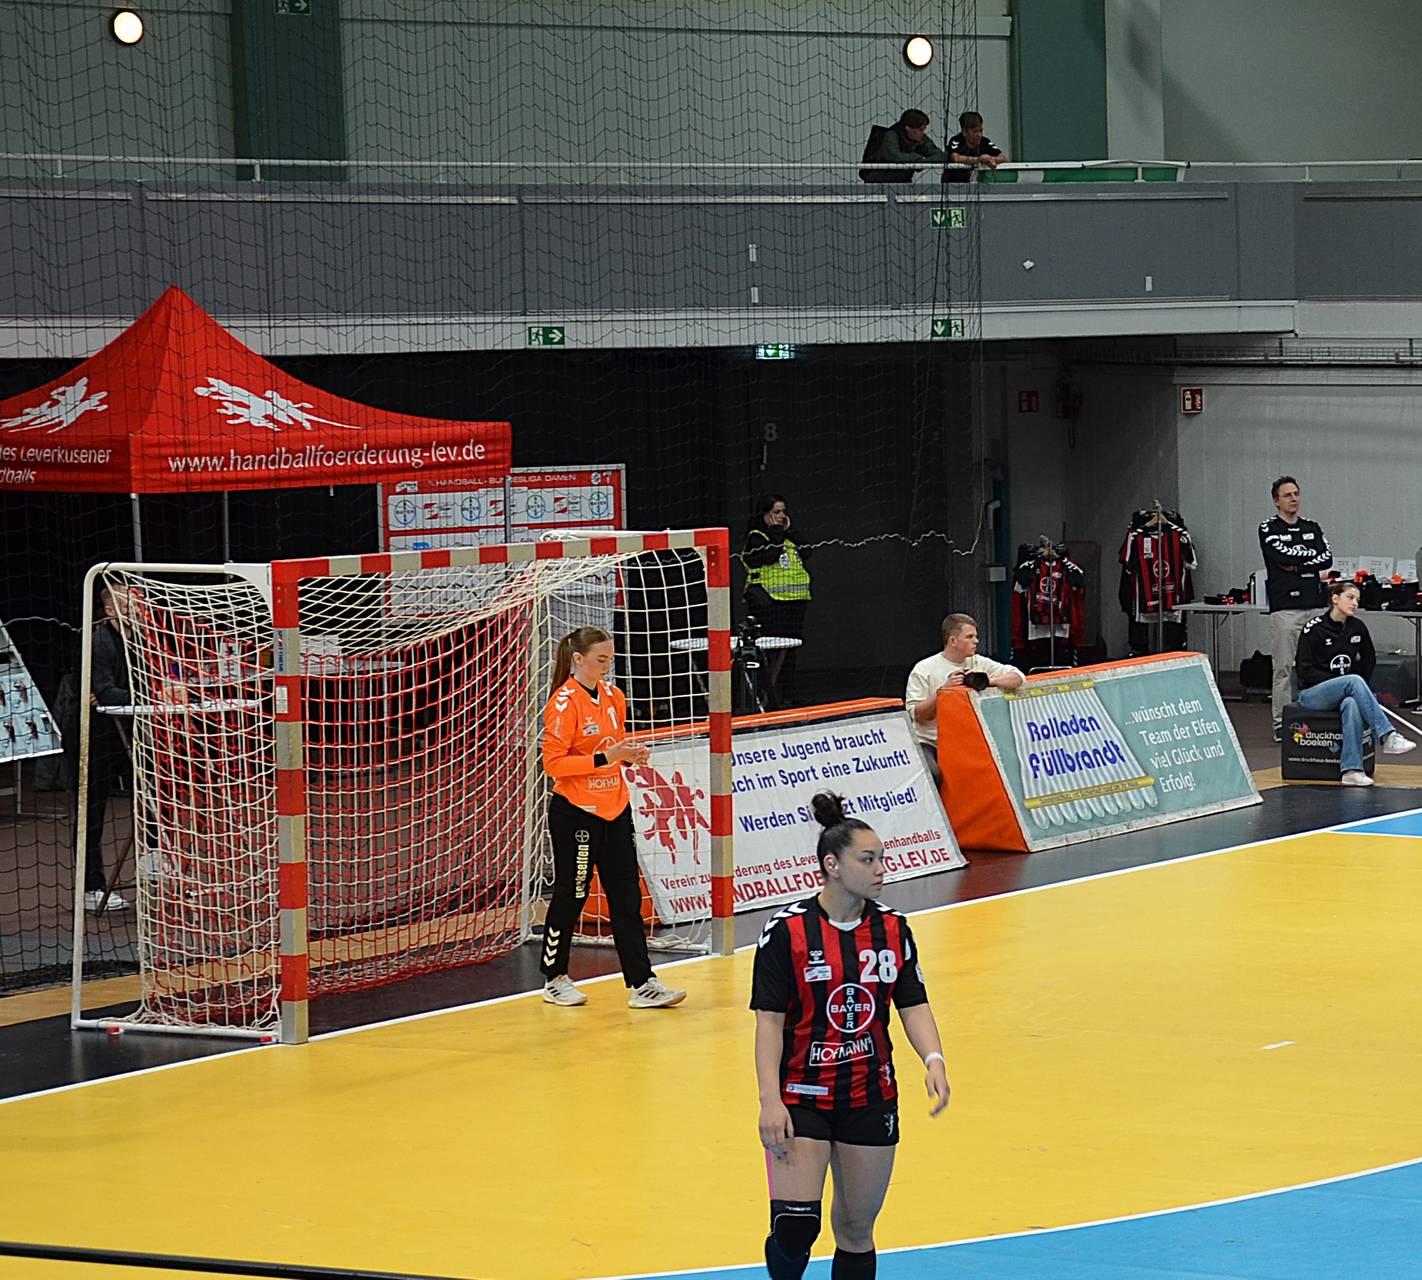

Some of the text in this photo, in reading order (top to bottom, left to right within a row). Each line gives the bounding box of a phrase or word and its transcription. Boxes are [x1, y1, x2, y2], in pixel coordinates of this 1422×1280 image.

[20, 445, 112, 464] Leverkusener
[168, 439, 485, 474] www.handballfoerderung-lev.de
[1179, 698, 1203, 715] dem
[1027, 714, 1101, 742] Rolladen
[1139, 718, 1220, 746] Team der Elfen
[781, 740, 830, 763] Jugend
[833, 729, 887, 751] braucht
[1150, 740, 1225, 769] viel Glück und
[1300, 739, 1334, 747] boeken
[732, 749, 911, 794] uch im Sport eine Zukunft!
[1028, 740, 1126, 779] Füllbrandt
[1160, 772, 1197, 792] Erfolg!
[739, 810, 796, 833] Werden
[800, 805, 814, 823] Si
[859, 786, 918, 813] Mitglied!
[660, 875, 697, 890] Verein
[700, 873, 712, 885] zu
[774, 857, 792, 872] des
[859, 949, 898, 983] 28
[831, 1004, 871, 1014] BAYER
